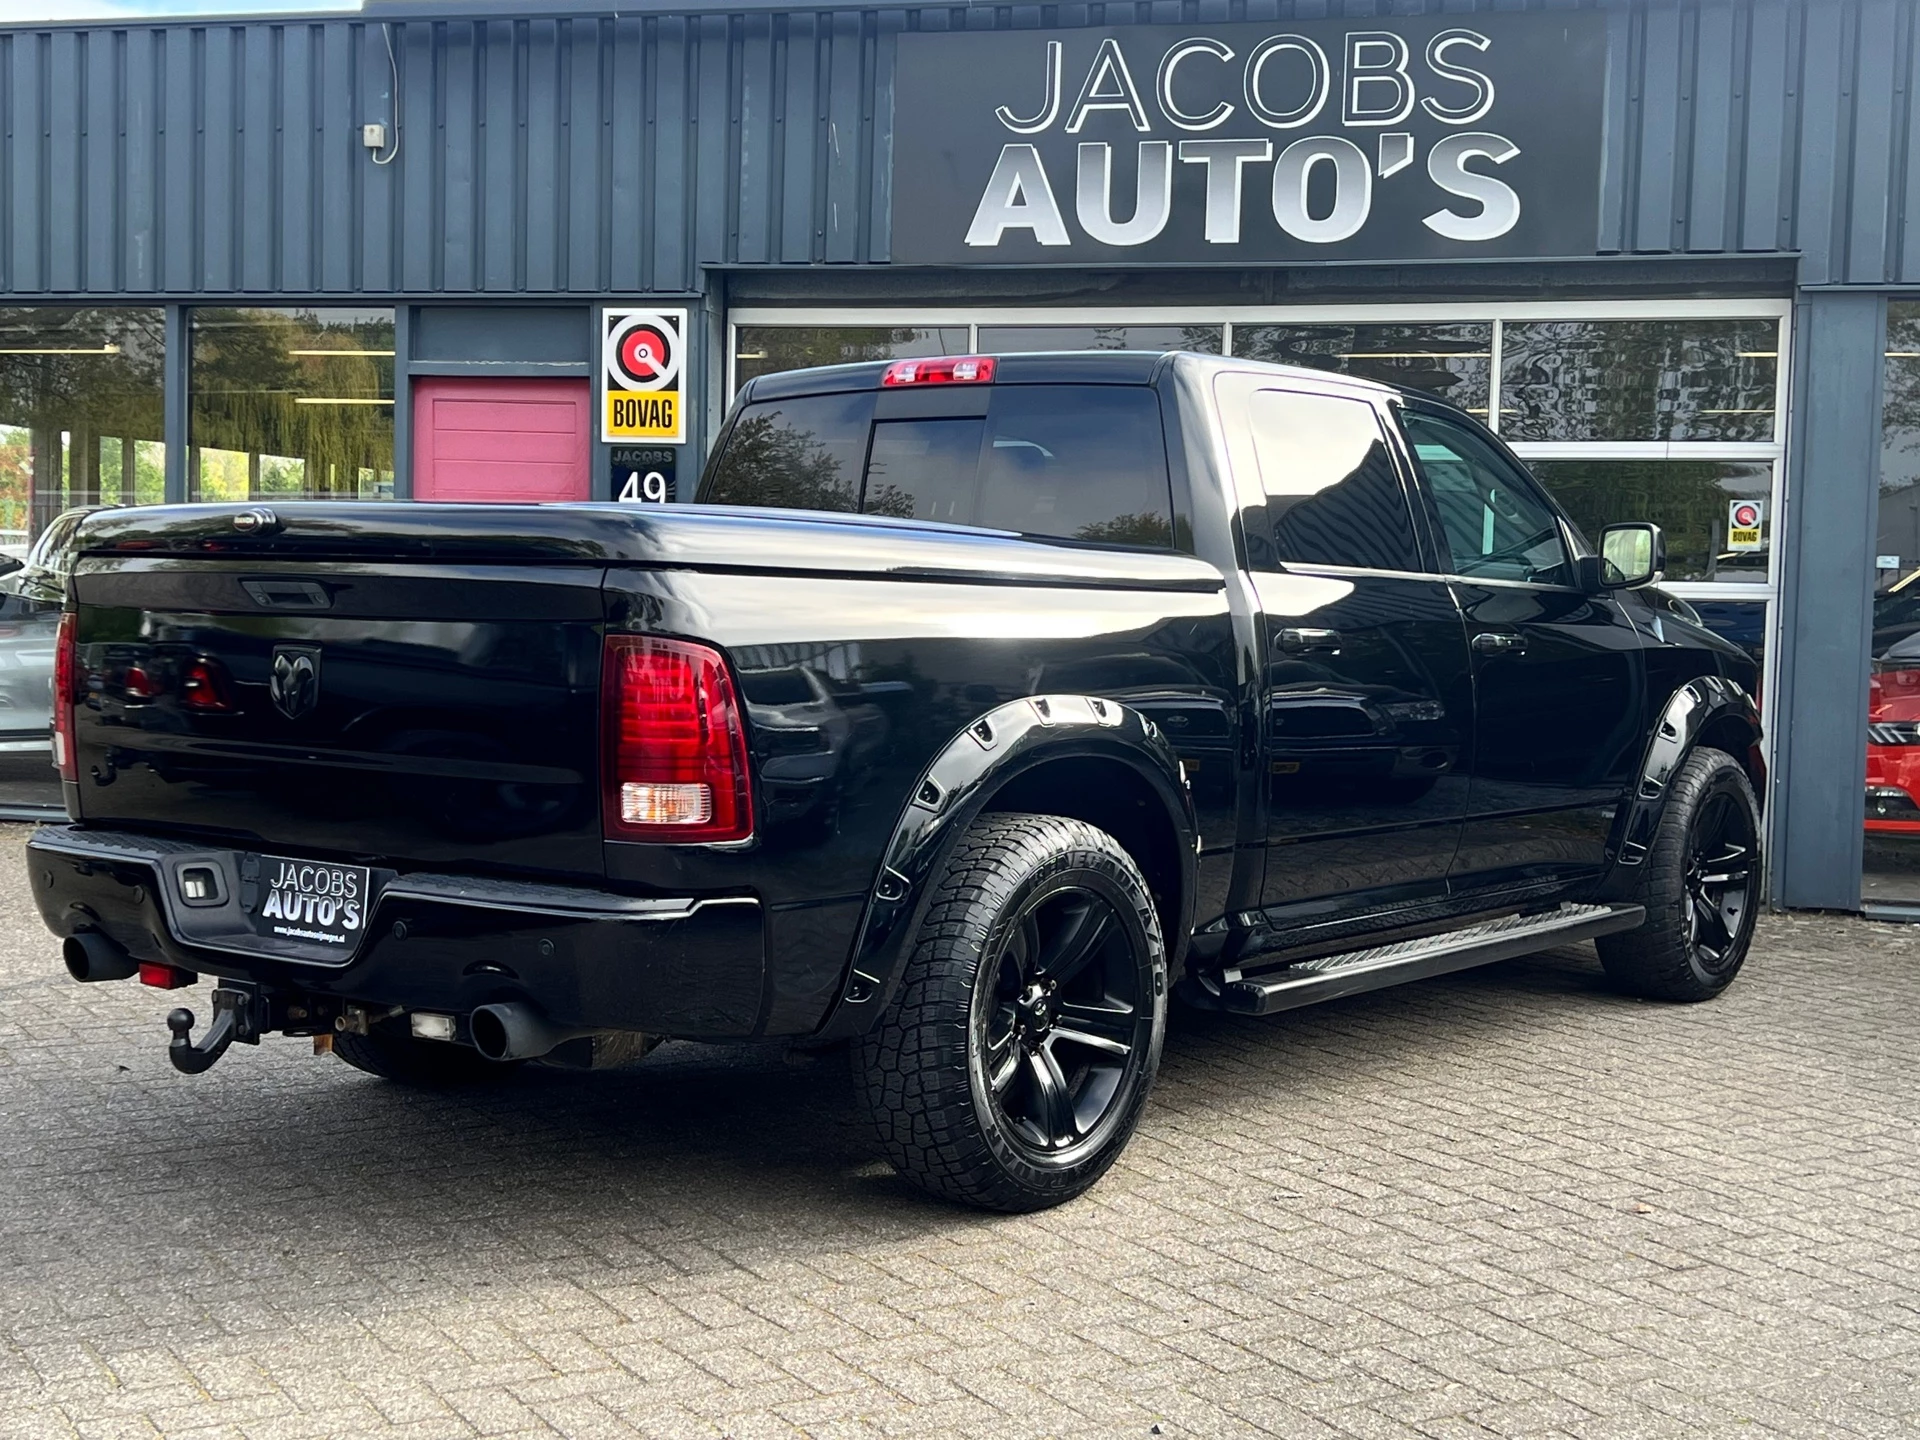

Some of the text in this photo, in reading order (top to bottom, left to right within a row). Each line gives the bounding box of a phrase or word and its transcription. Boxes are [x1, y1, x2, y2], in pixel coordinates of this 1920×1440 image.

[994, 28, 1495, 134] JACOBS
[964, 131, 1521, 246] AUTO'S
[613, 398, 673, 429] BOVAG
[613, 450, 673, 462] JACOBS
[618, 471, 666, 504] 49
[1732, 531, 1757, 542] BOVAG
[270, 863, 357, 898] JACOBS
[1028, 852, 1141, 902] RENEGADE
[262, 888, 361, 930] AUTO'S
